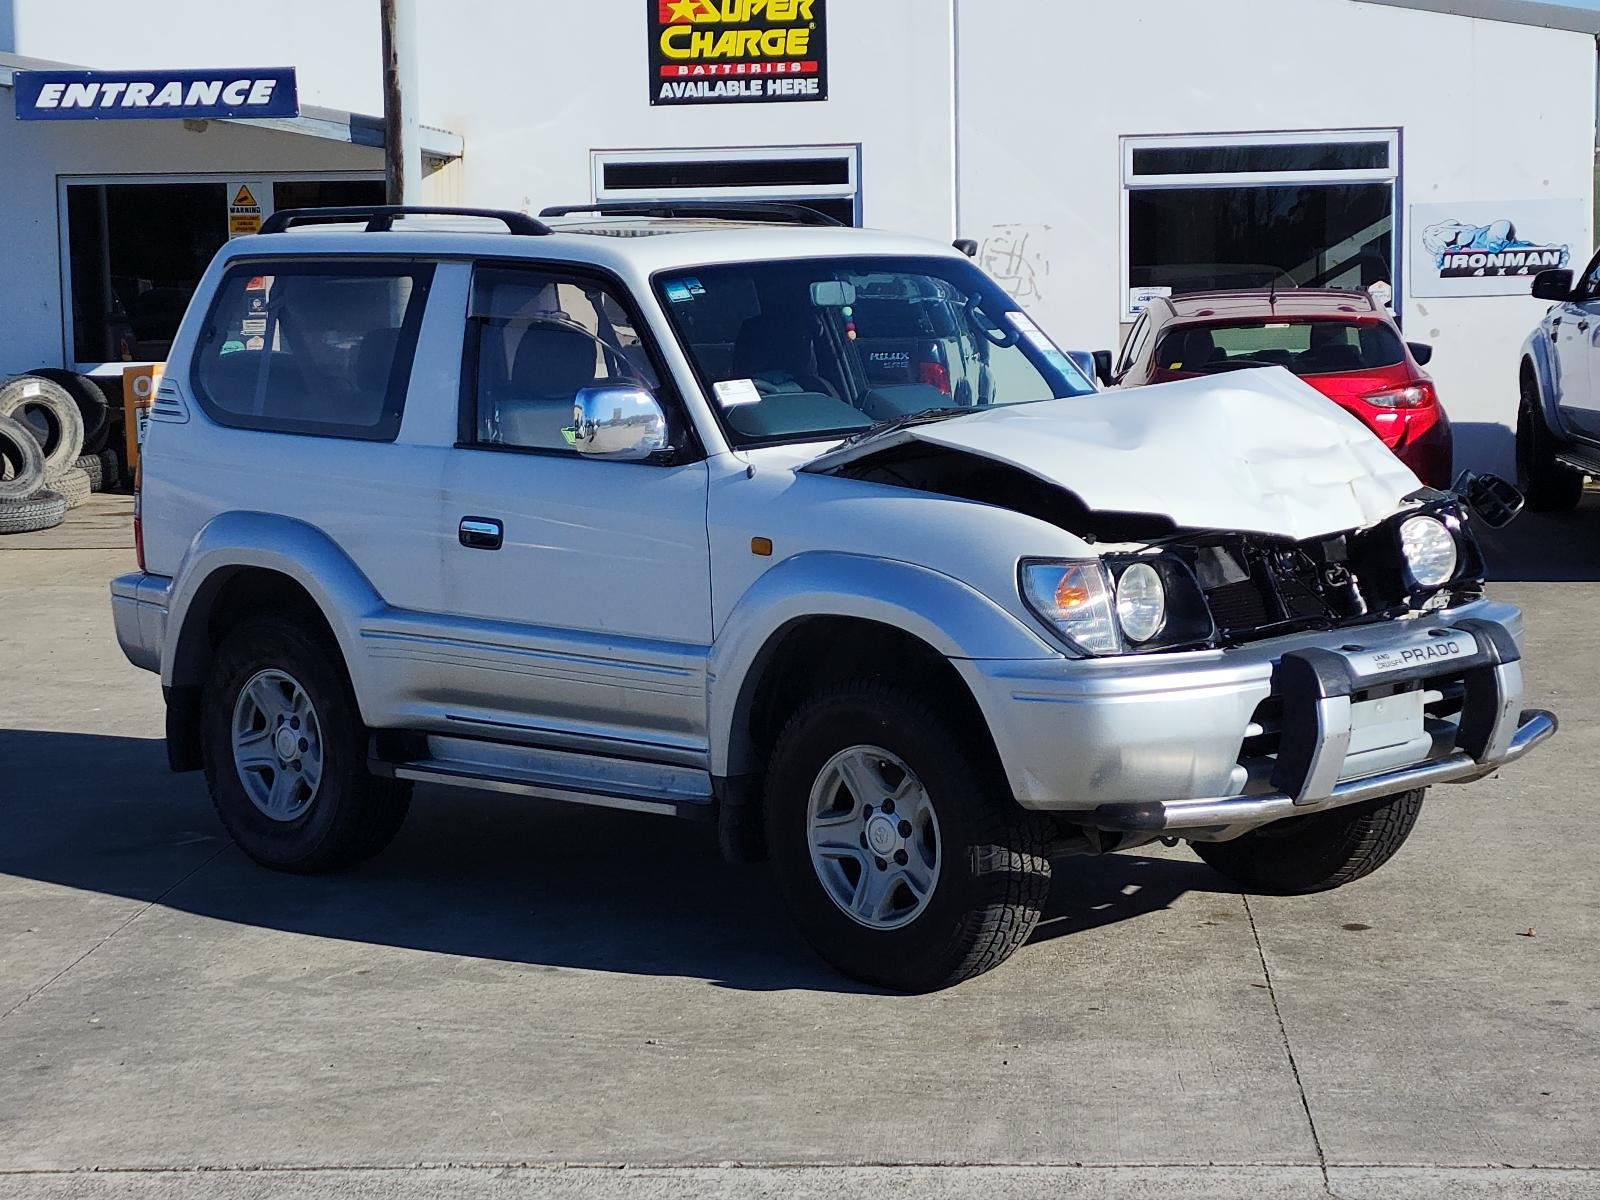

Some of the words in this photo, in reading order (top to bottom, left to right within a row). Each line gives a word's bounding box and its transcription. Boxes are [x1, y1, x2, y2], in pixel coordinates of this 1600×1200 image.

[695, 0, 814, 22] SUPER
[660, 25, 810, 58] CHARGE
[678, 62, 802, 75] BATTERIES
[34, 79, 277, 108] ENTRANCE
[659, 79, 763, 99] AVAILABLE
[767, 78, 819, 95] HERE
[1443, 251, 1561, 269] IRONMAN
[1400, 641, 1460, 663] PRADO
